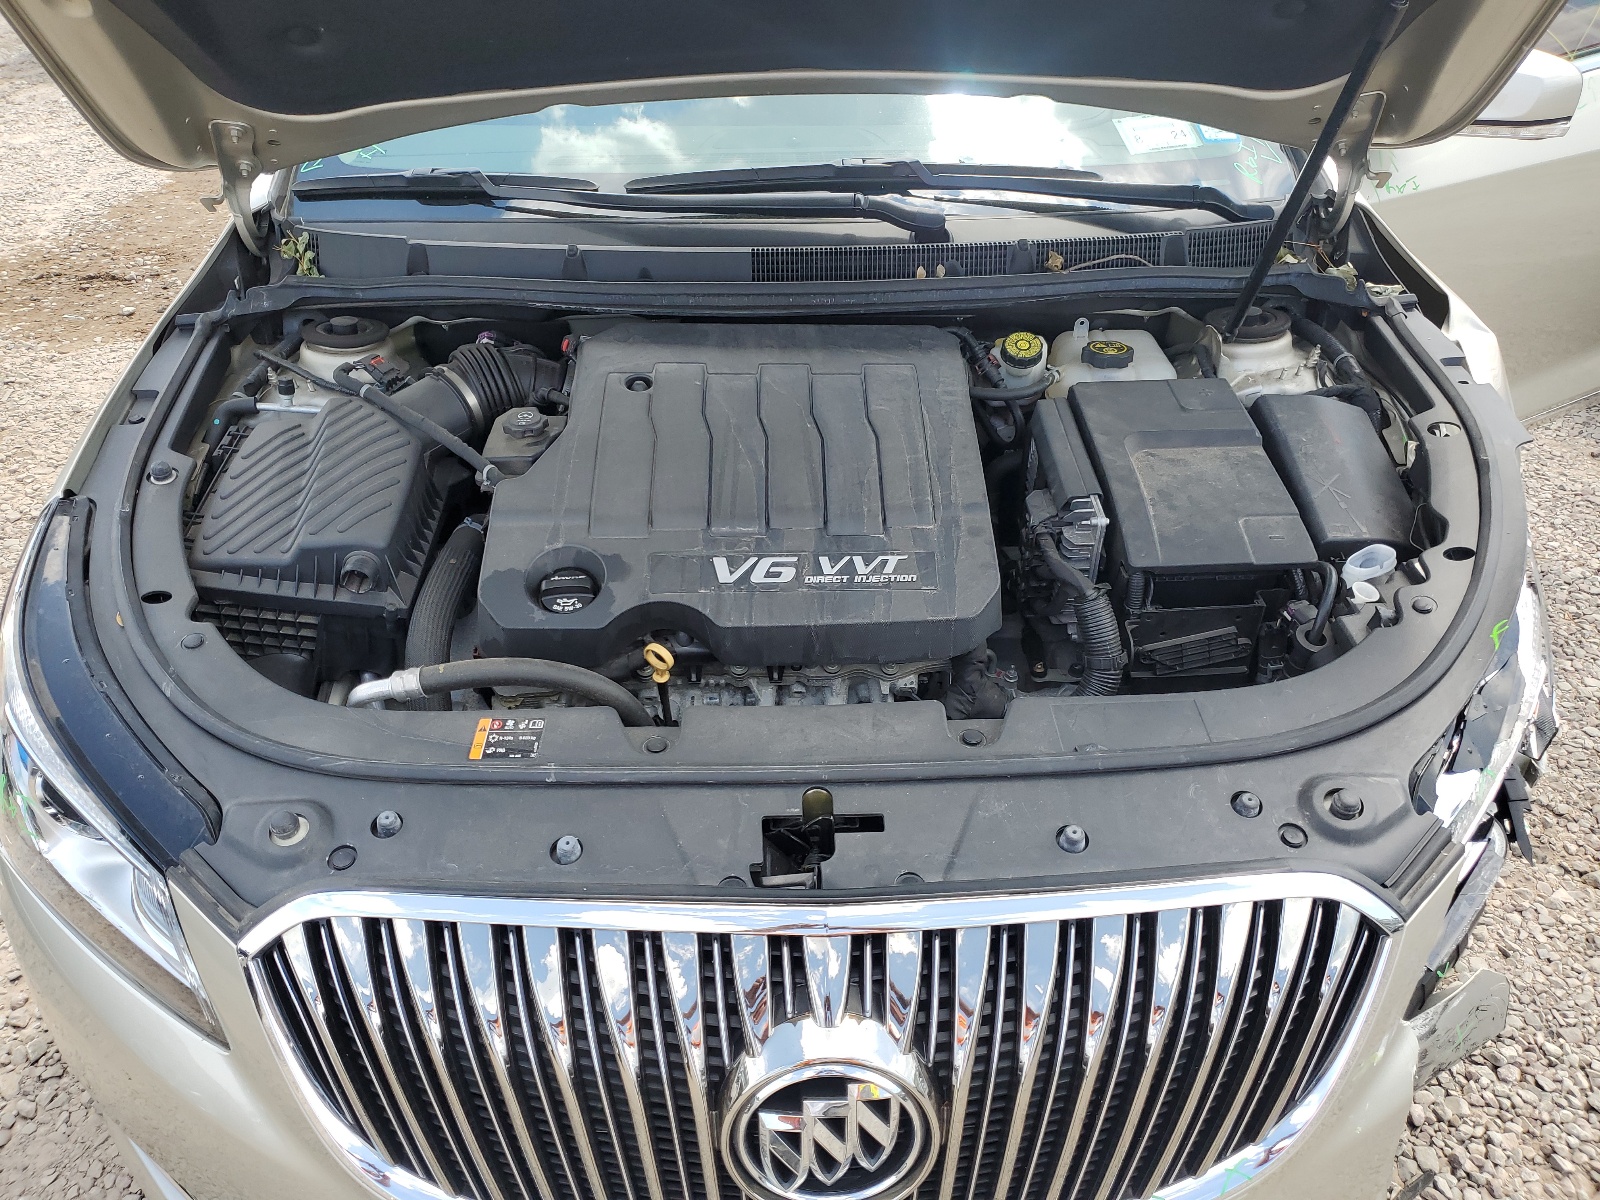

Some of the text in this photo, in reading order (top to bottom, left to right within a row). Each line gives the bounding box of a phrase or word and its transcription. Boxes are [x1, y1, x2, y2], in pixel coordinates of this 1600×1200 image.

[711, 556, 799, 584] V6
[818, 554, 909, 575] VVT
[804, 574, 917, 584] DIRECT INJECTION
